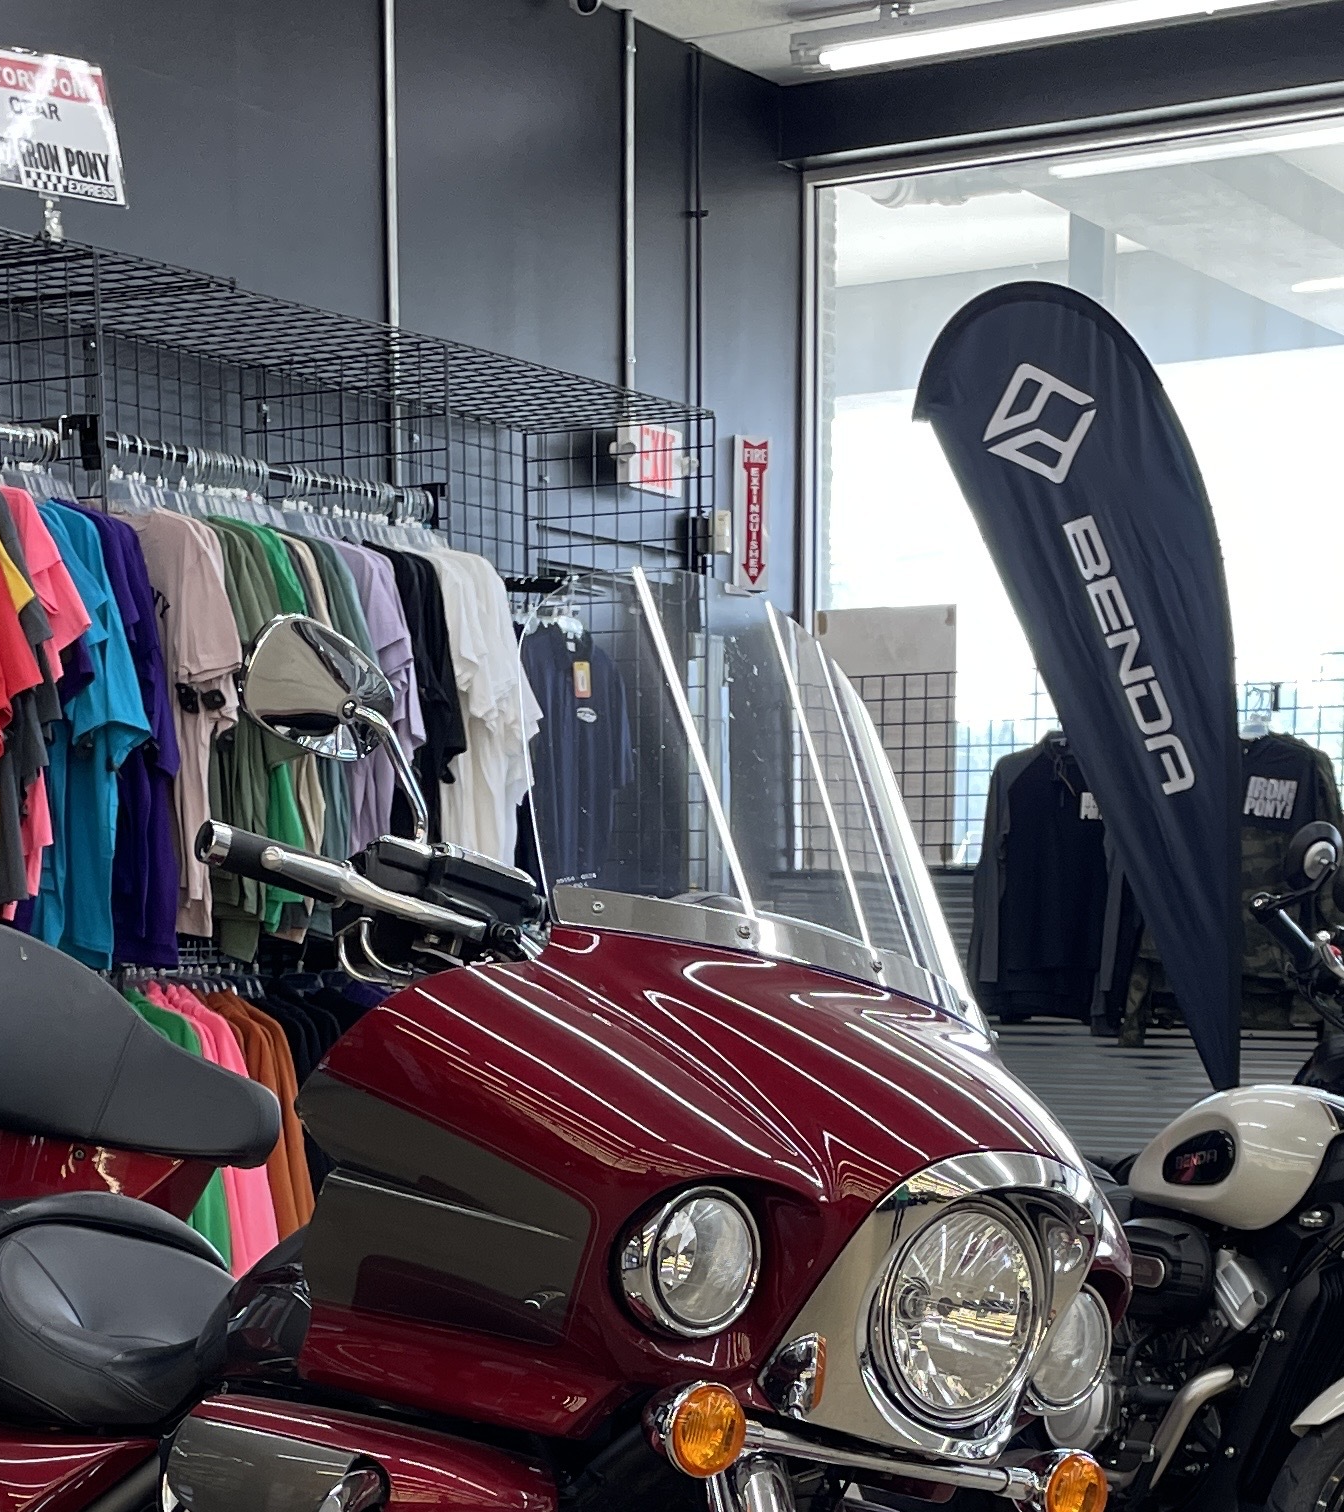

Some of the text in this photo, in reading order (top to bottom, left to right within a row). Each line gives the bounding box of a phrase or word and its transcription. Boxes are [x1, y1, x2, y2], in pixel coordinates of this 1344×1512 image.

[63, 146, 109, 182] PONY
[67, 181, 116, 200] EXPRESS
[744, 448, 768, 463] FIRE
[749, 467, 760, 577] EXTINGUISHER
[1062, 515, 1195, 796] BENDA
[1247, 776, 1290, 800] IRON
[1243, 797, 1286, 819] PONY
[1176, 1149, 1218, 1170] BENDA
